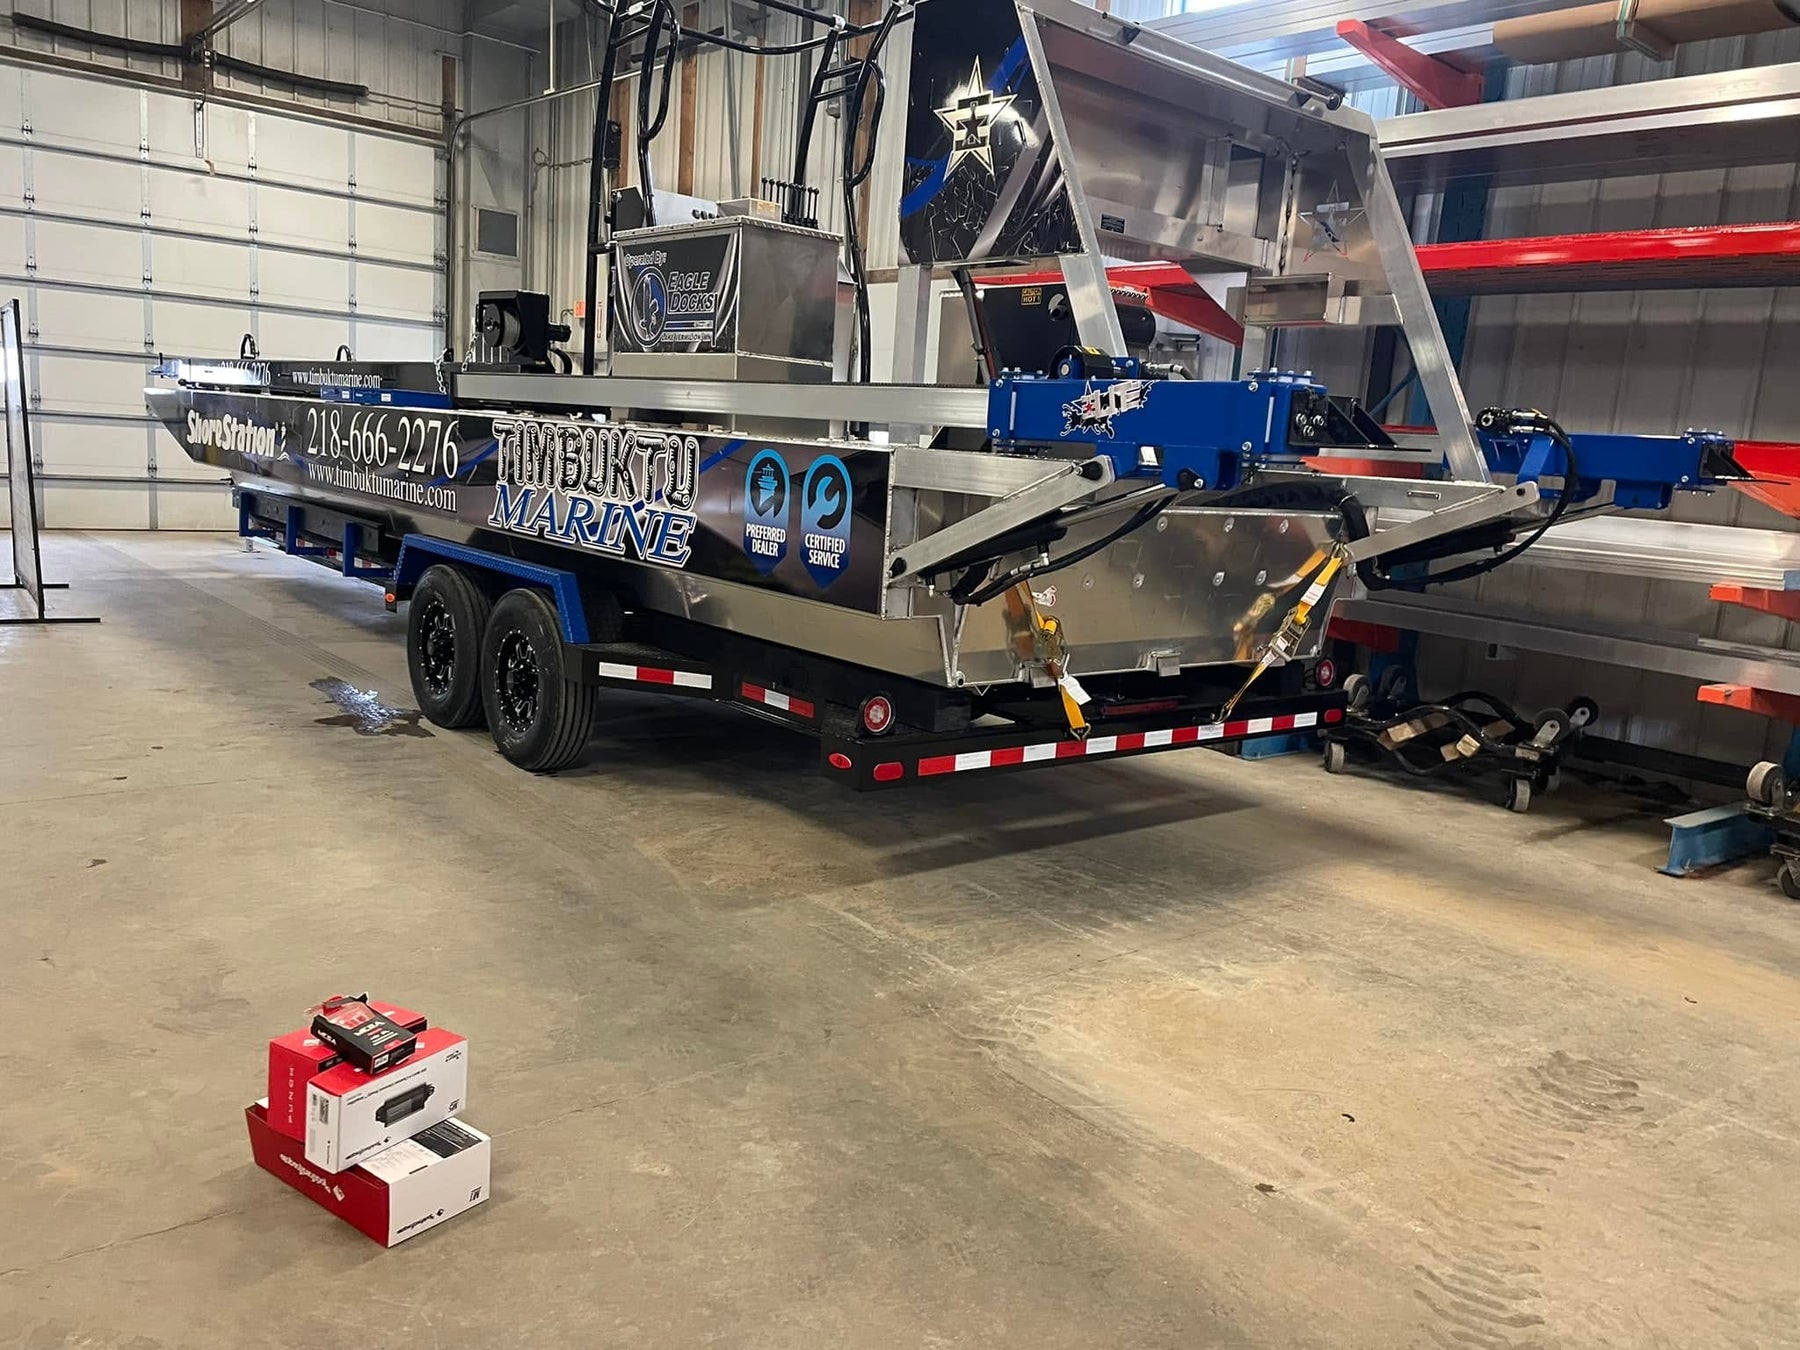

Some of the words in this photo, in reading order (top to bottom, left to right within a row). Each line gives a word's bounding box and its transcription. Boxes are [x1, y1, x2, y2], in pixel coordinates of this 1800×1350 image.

[624, 251, 654, 269] Operated
[668, 272, 710, 292] EAGLE
[671, 292, 715, 312] DOCKS
[187, 409, 276, 457] ShoreStation
[307, 407, 459, 479] 218-666-2276
[493, 420, 700, 511] TIMBUKTU
[308, 461, 457, 511] www.timbuktumarine.com
[489, 482, 697, 568] MARINE
[746, 523, 786, 543] PREFERRED
[752, 539, 779, 557] DEALER
[805, 533, 846, 553] CERTIFIED
[808, 549, 840, 569] SERVICE
